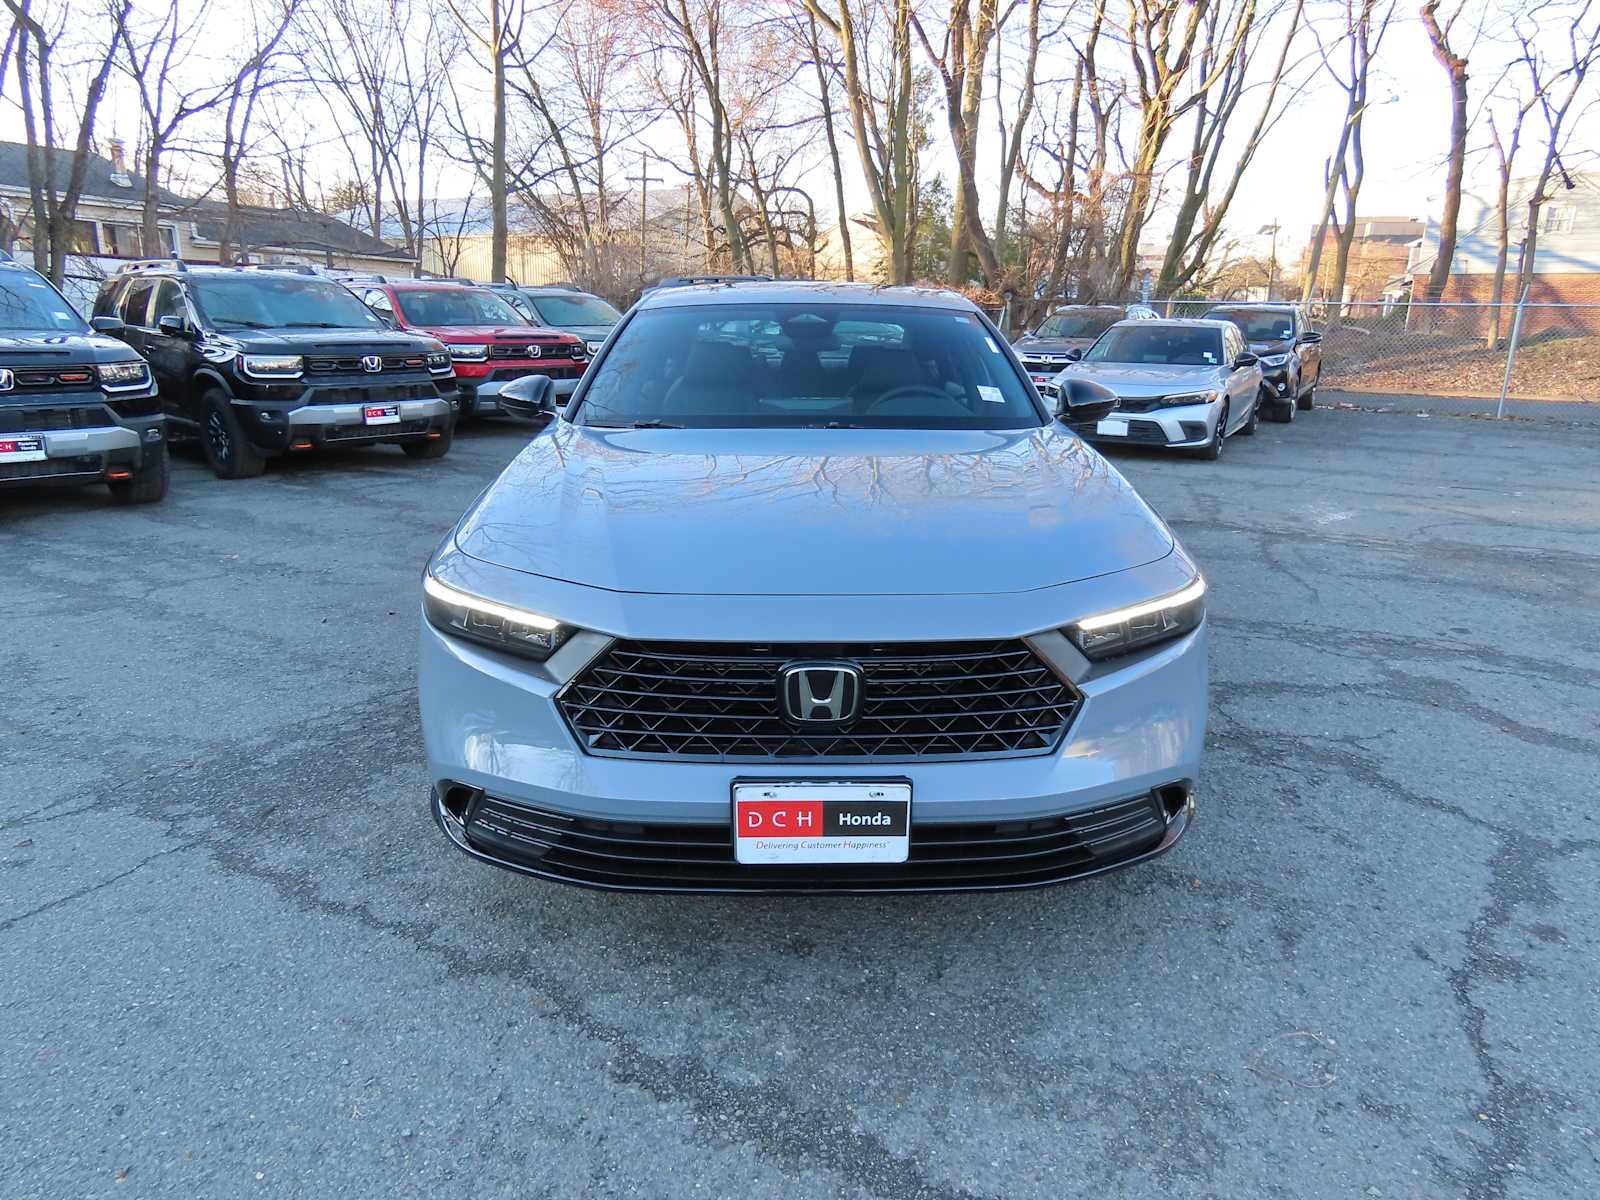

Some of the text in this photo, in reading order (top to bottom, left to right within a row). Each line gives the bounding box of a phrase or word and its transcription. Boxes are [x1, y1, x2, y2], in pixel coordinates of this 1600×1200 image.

[839, 812, 891, 826] Honda
[756, 840, 887, 851] Delivering Customer Happiness
